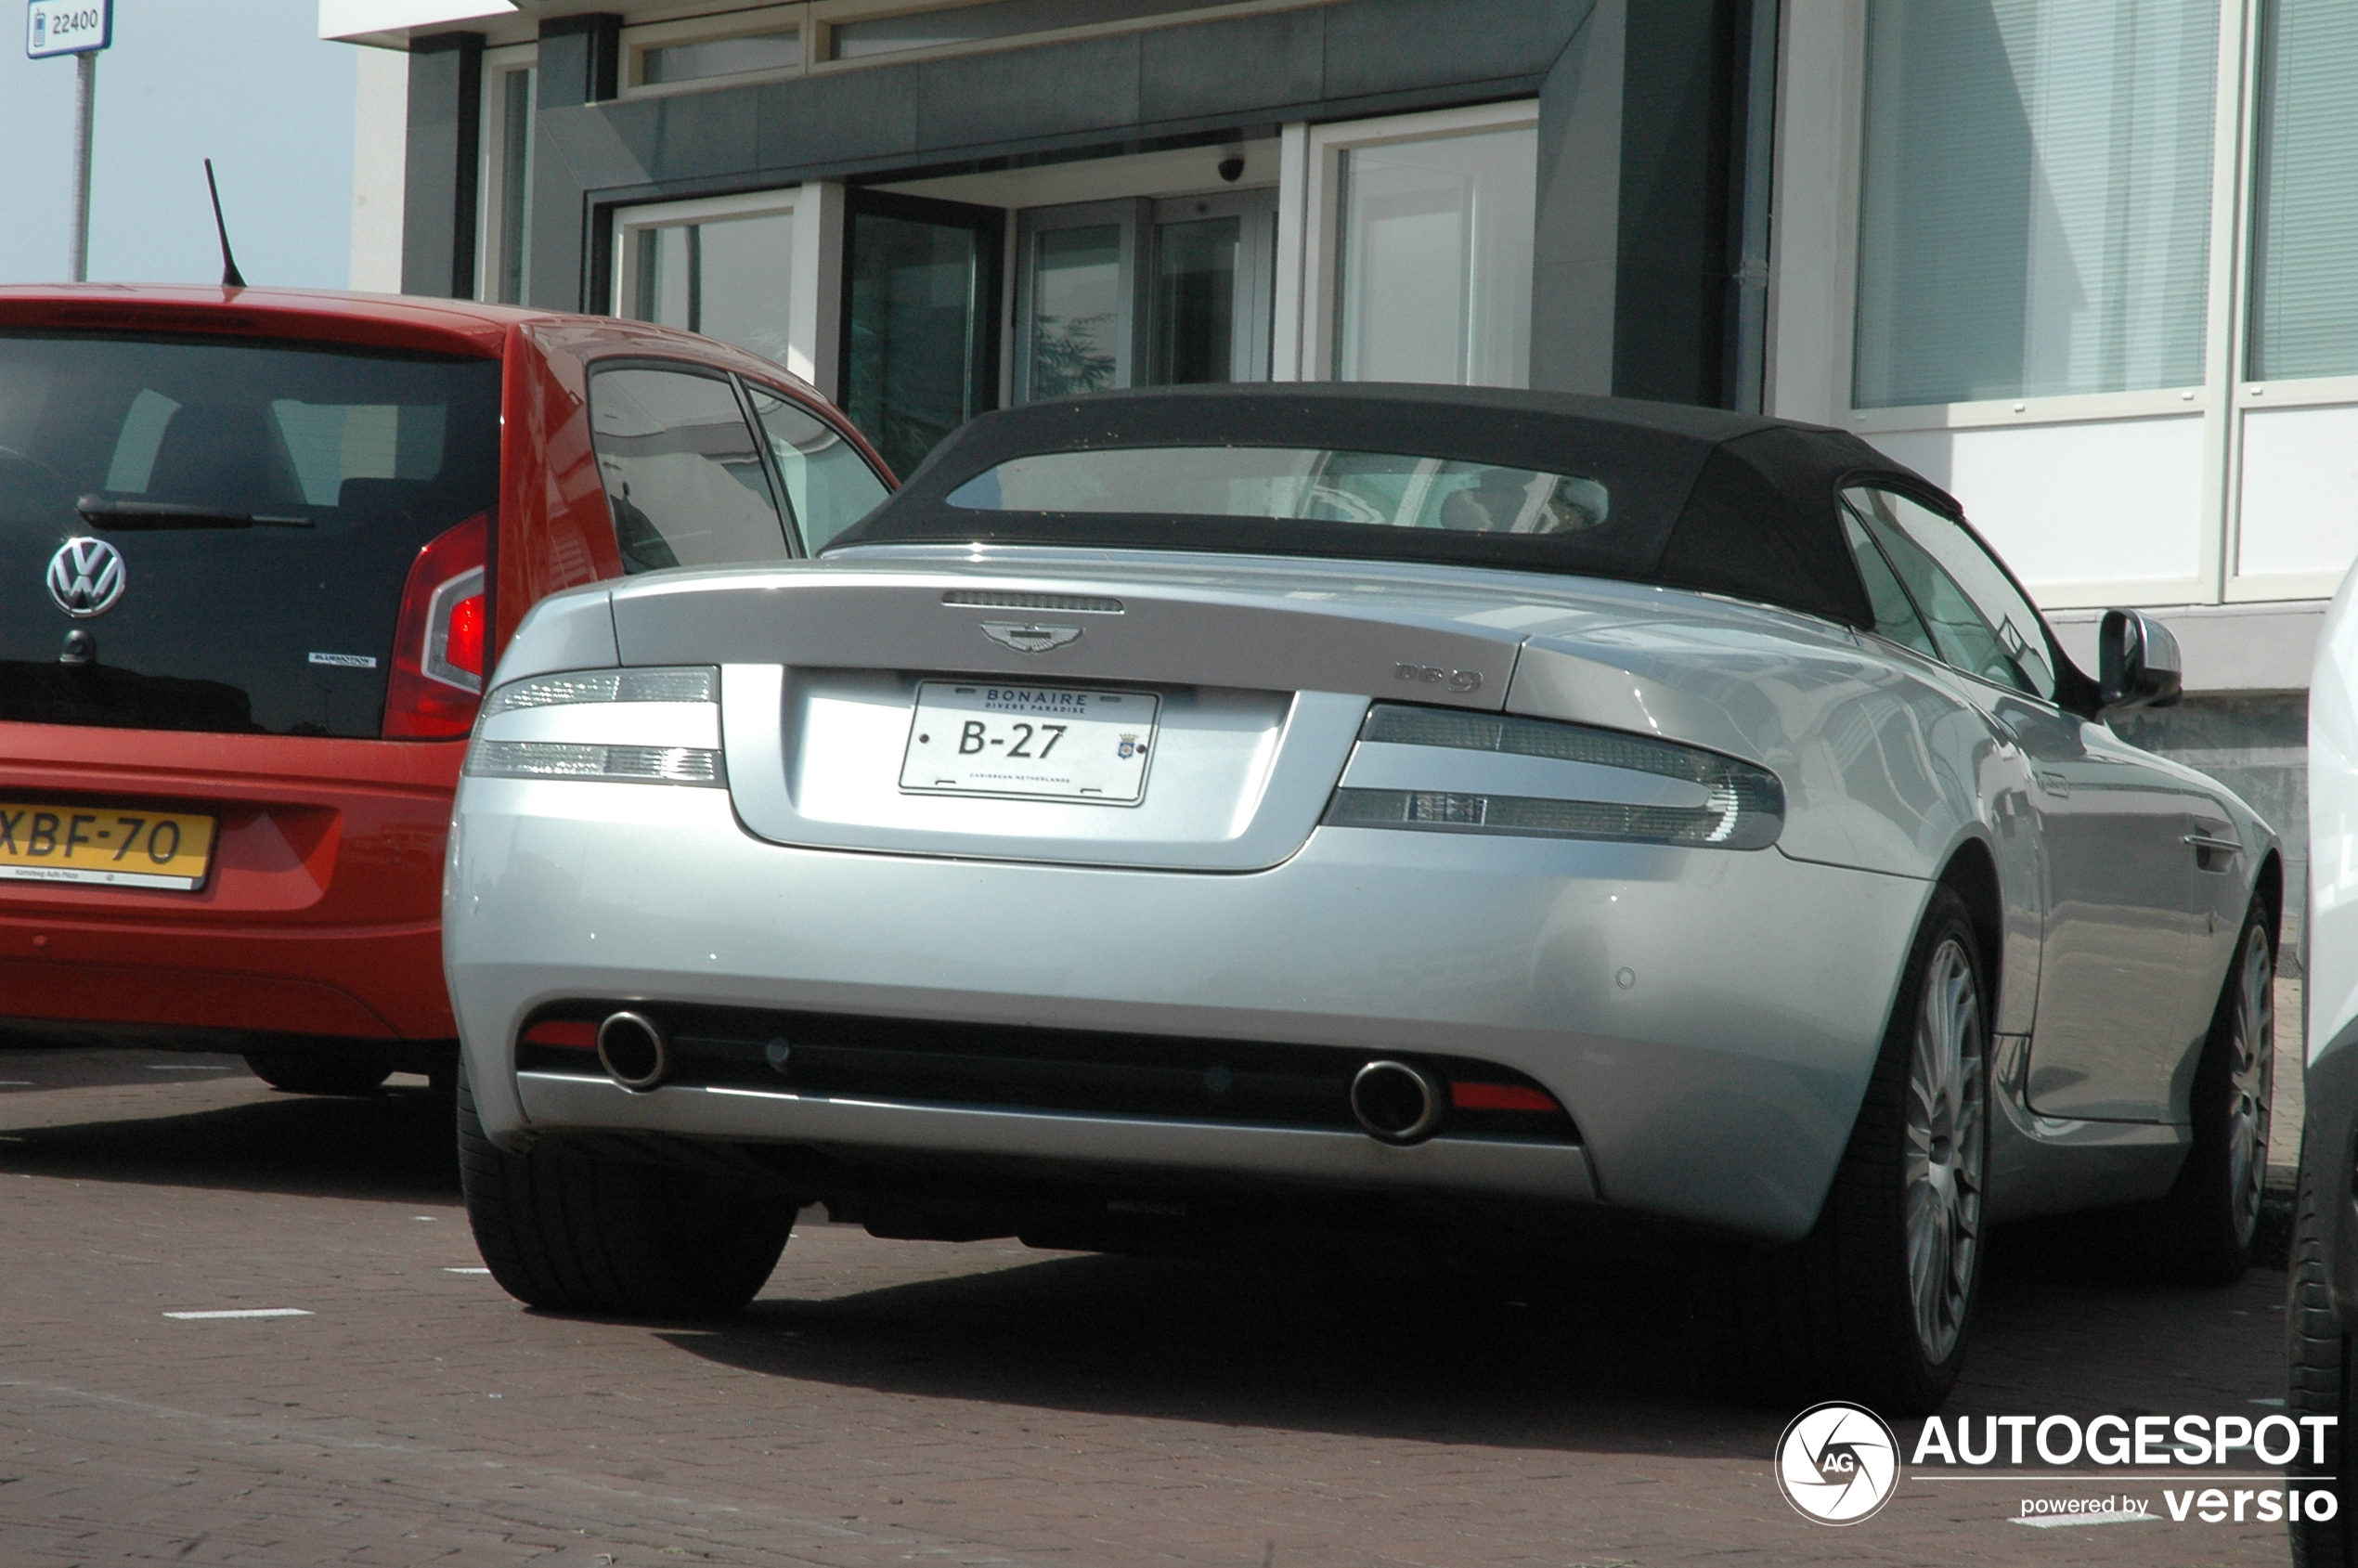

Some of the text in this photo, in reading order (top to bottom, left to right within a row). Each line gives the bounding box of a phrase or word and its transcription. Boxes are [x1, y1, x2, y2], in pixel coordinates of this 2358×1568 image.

[53, 9, 98, 34] 22400
[987, 688, 1088, 706] BONAIRE
[985, 702, 1086, 714] DIVERS PARADISE
[958, 720, 1068, 758] B-27
